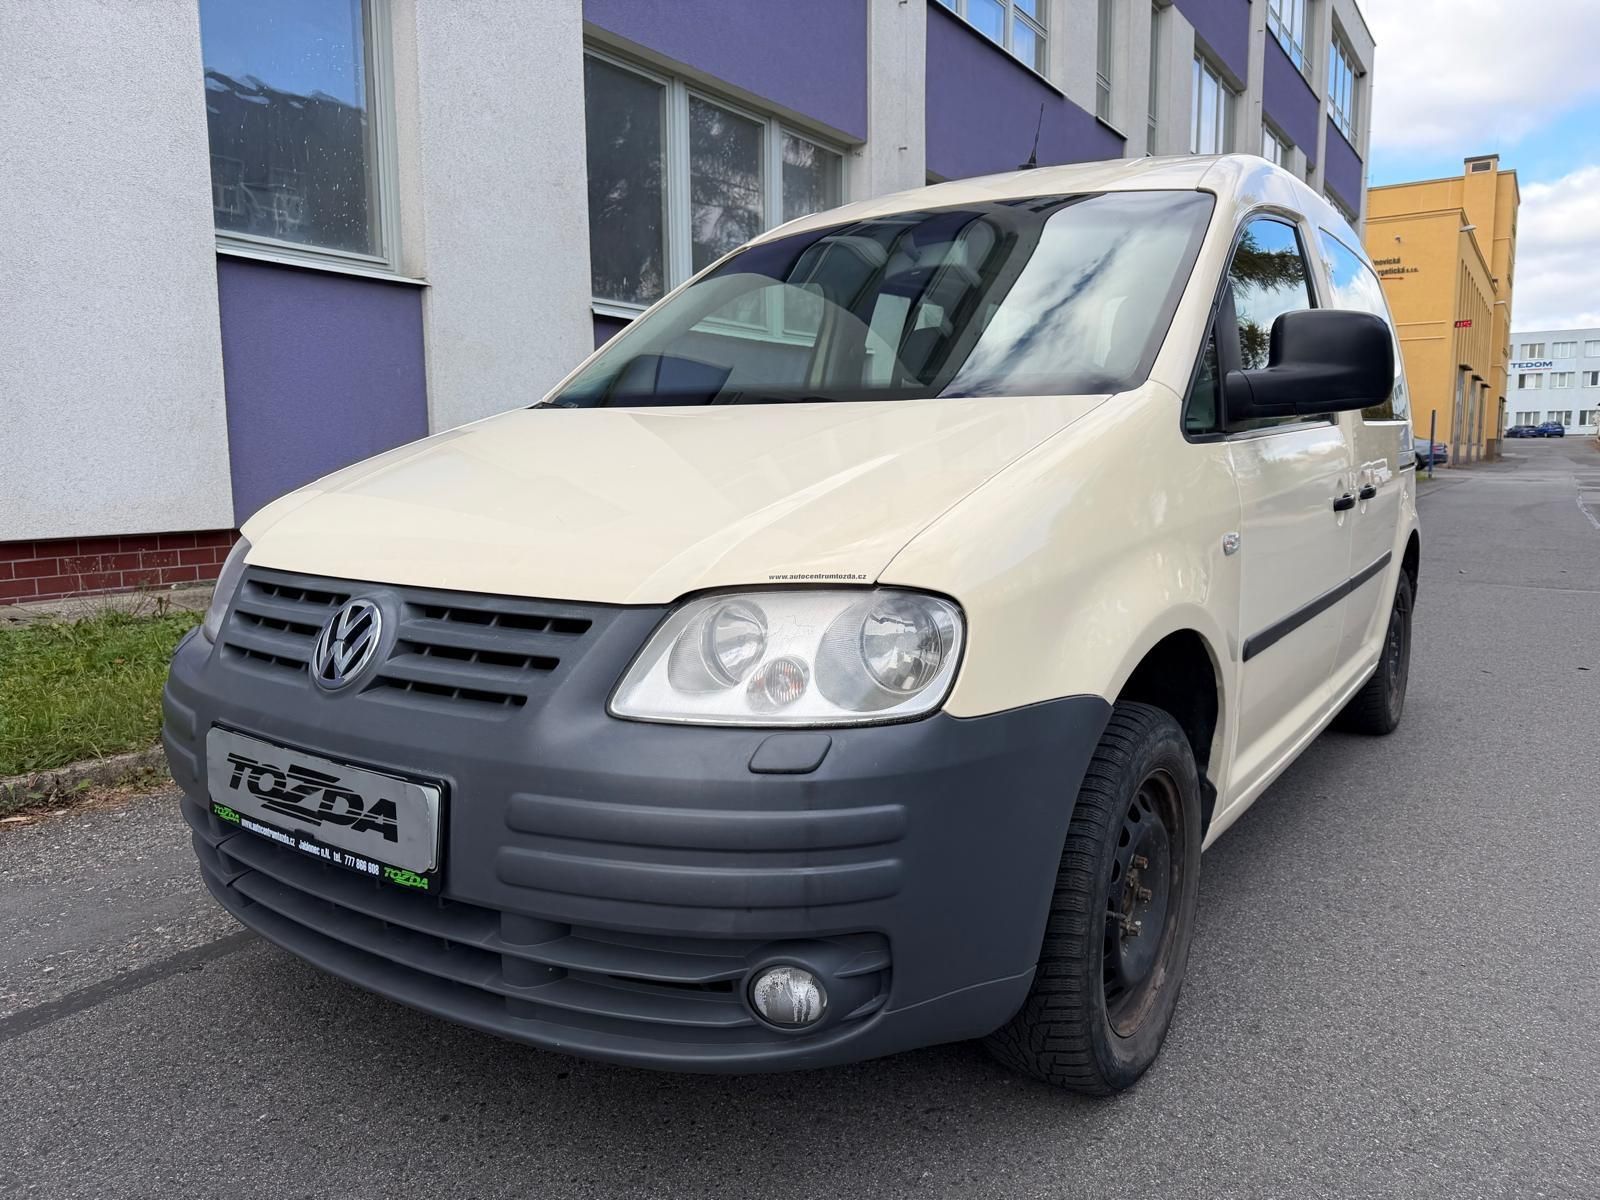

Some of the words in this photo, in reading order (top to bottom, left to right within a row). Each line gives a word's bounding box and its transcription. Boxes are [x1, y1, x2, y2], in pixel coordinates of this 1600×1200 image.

[1511, 361, 1553, 369] TEDOM
[226, 752, 399, 843] TOZDA
[213, 803, 240, 824] TOZDA
[298, 839, 321, 855] Jablonec
[344, 854, 355, 867] 777
[383, 866, 429, 890] TOZDA
